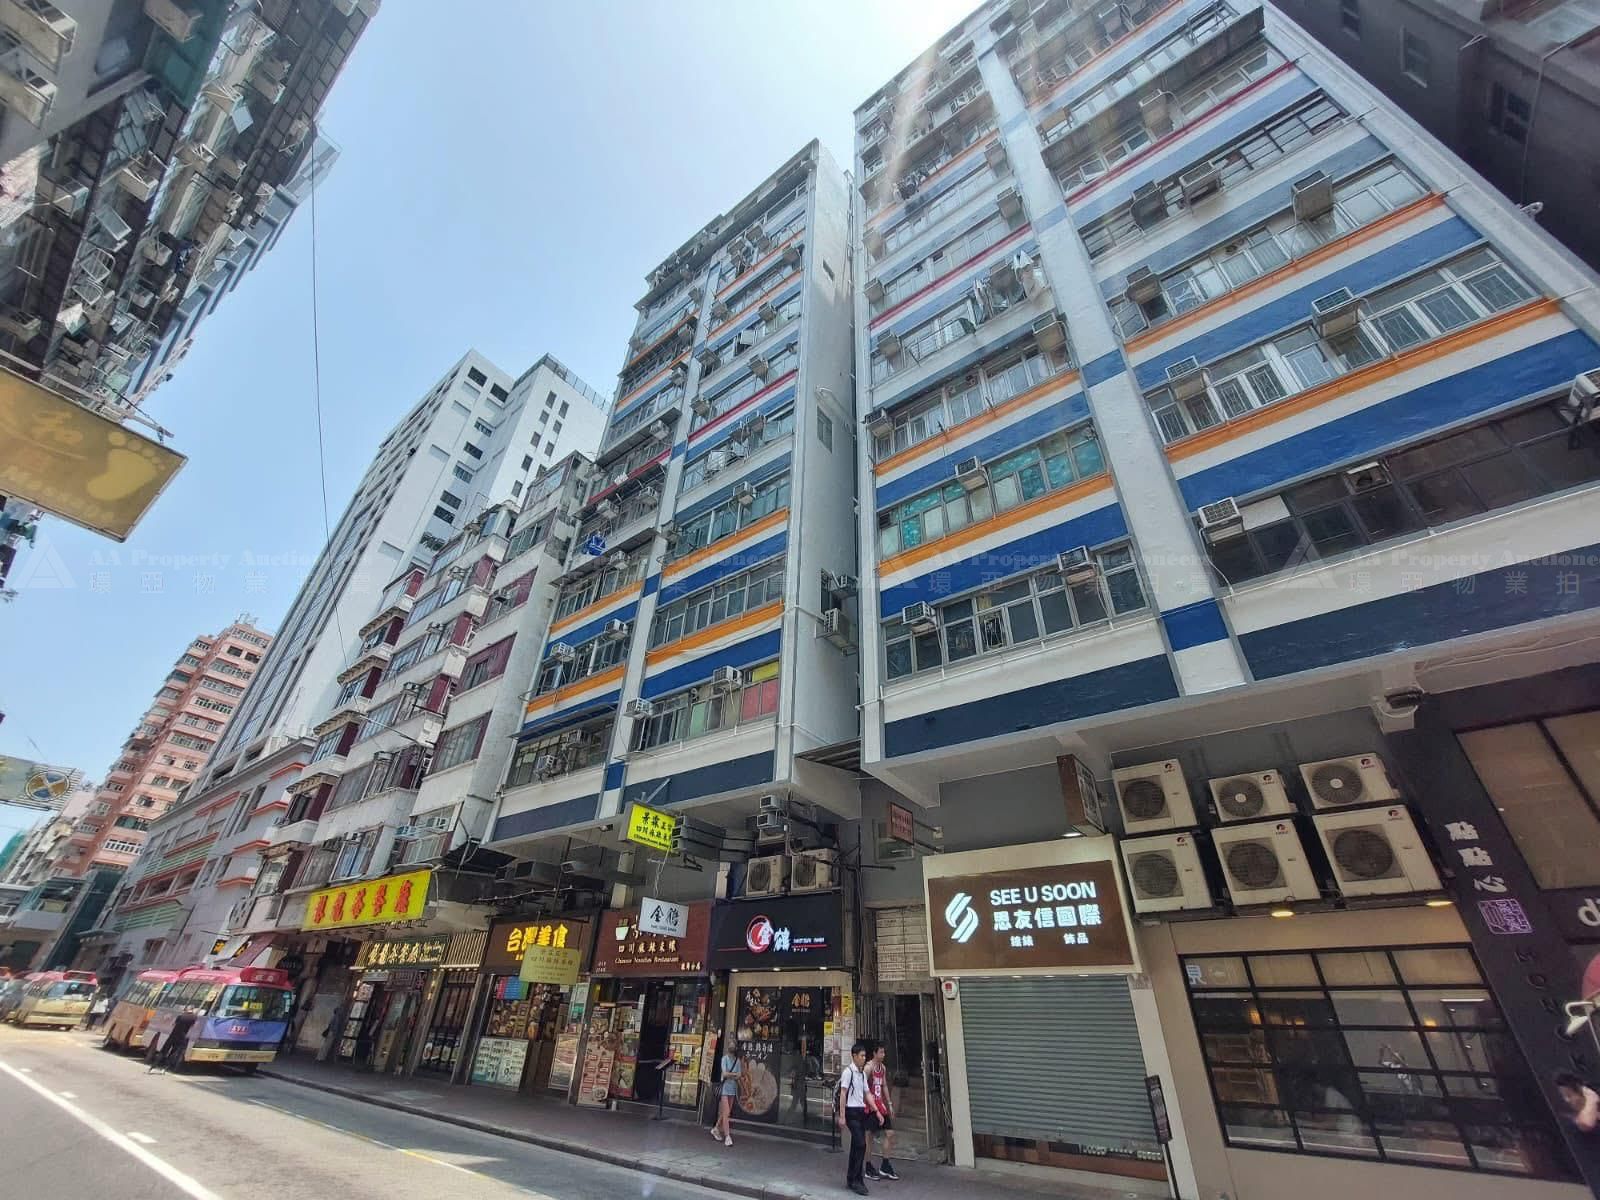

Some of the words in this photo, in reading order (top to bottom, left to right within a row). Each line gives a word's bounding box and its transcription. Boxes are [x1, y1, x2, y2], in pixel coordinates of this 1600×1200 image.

[1445, 821, 1508, 893] 點點心
[990, 888, 1022, 906] SEE
[1024, 886, 1038, 904] U
[1041, 881, 1097, 902] SOON
[1063, 932, 1089, 945] 飾品
